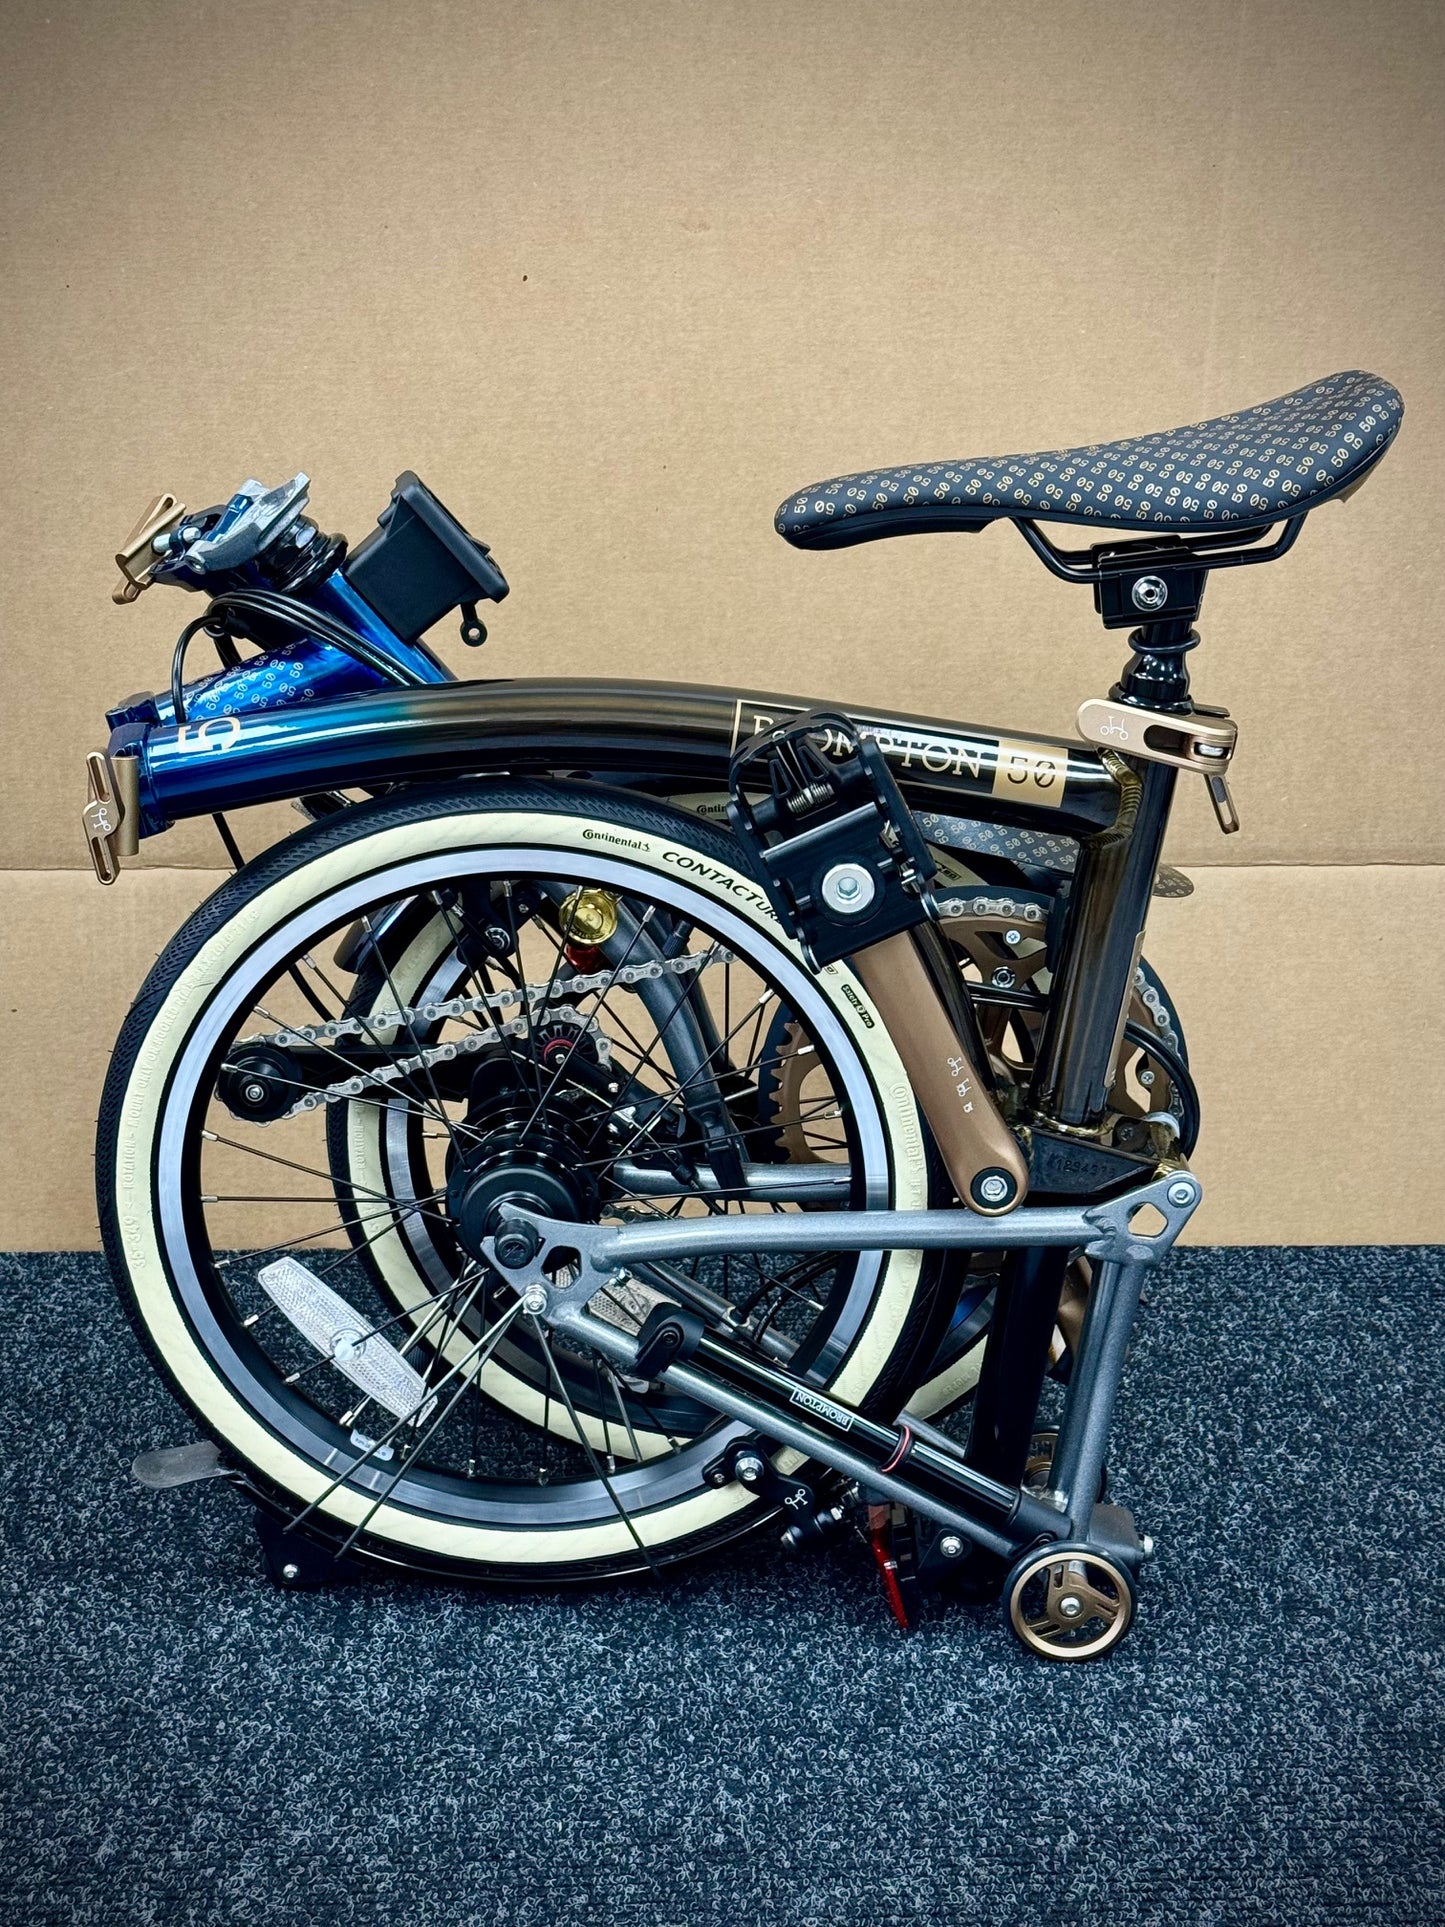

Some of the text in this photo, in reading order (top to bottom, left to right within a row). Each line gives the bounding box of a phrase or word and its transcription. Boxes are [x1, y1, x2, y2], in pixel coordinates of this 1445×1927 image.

[1316, 386, 1334, 394] 50
[1284, 397, 1303, 406] 50
[1253, 407, 1271, 415] 50
[1339, 412, 1357, 420] 50
[1372, 404, 1389, 421] 50
[1306, 424, 1323, 433] 50
[1325, 424, 1342, 437] 50
[1359, 416, 1377, 432] 50
[1203, 443, 1220, 451] 50
[1272, 437, 1290, 446] 50
[1292, 437, 1309, 450] 50
[1344, 432, 1363, 450] 50
[1154, 447, 1170, 458] 50
[1223, 443, 1239, 455] 50
[1239, 448, 1257, 458] 50
[1309, 442, 1328, 454] 50
[1122, 455, 1138, 467] 50
[1171, 452, 1188, 461] 50
[1190, 453, 1206, 466] 50
[1259, 449, 1276, 462] 50
[1276, 455, 1294, 466] 50
[1331, 448, 1349, 468] 50
[1040, 462, 1058, 472] 50
[1072, 458, 1089, 467] 50
[1091, 461, 1107, 474] 50
[1139, 461, 1157, 472] 50
[1207, 459, 1225, 470] 50
[1226, 460, 1243, 476] 50
[1296, 457, 1314, 475] 50
[945, 471, 963, 483] 50
[977, 468, 995, 480] 50
[1008, 465, 1026, 477] 50
[1059, 467, 1076, 482] 50
[1108, 469, 1126, 482] 50
[1159, 463, 1175, 479] 50
[1176, 471, 1193, 484] 50
[1243, 467, 1261, 480] 50
[913, 475, 931, 487] 50
[996, 476, 1013, 492] 50
[1028, 472, 1045, 488] 50
[1077, 477, 1094, 492] 50
[1127, 474, 1144, 491] 50
[1195, 473, 1211, 490] 50
[1263, 469, 1280, 488] 50
[826, 483, 843, 495] 50
[880, 480, 899, 492] 50
[934, 482, 950, 499] 50
[965, 479, 981, 496] 50
[1045, 484, 1063, 500] 50
[1145, 483, 1163, 497] 50
[1212, 481, 1229, 495] 50
[1282, 480, 1301, 497] 50
[847, 488, 866, 501] 50
[902, 486, 919, 505] 50
[1014, 489, 1032, 506] 50
[1097, 484, 1112, 502] 50
[1165, 487, 1181, 506] 50
[1231, 484, 1247, 503] 50
[794, 497, 808, 513] 50
[815, 501, 835, 515] 50
[872, 493, 888, 510] 50
[1065, 493, 1082, 511] 50
[1114, 495, 1133, 511] 50
[1182, 496, 1199, 512] 50
[1250, 494, 1268, 510] 50
[1136, 501, 1151, 520] 50
[1204, 500, 1217, 520] 50
[270, 659, 286, 671] 50
[290, 662, 304, 678] 50
[262, 672, 276, 688] 50
[234, 684, 248, 700] 50
[279, 683, 296, 696] 50
[206, 694, 220, 710] 50
[251, 694, 268, 707] 50
[1007, 756, 1057, 789] 50
[922, 814, 939, 827] 50
[951, 821, 967, 834] 50
[582, 828, 642, 850] Continental
[934, 829, 949, 844] 50
[979, 830, 994, 841] 50
[1020, 831, 1035, 845] 50
[1005, 838, 1021, 849] 50
[1047, 840, 1061, 852] 50
[1032, 847, 1048, 857] 50
[1060, 855, 1075, 865] 50
[795, 1389, 851, 1426] BROMPTON
